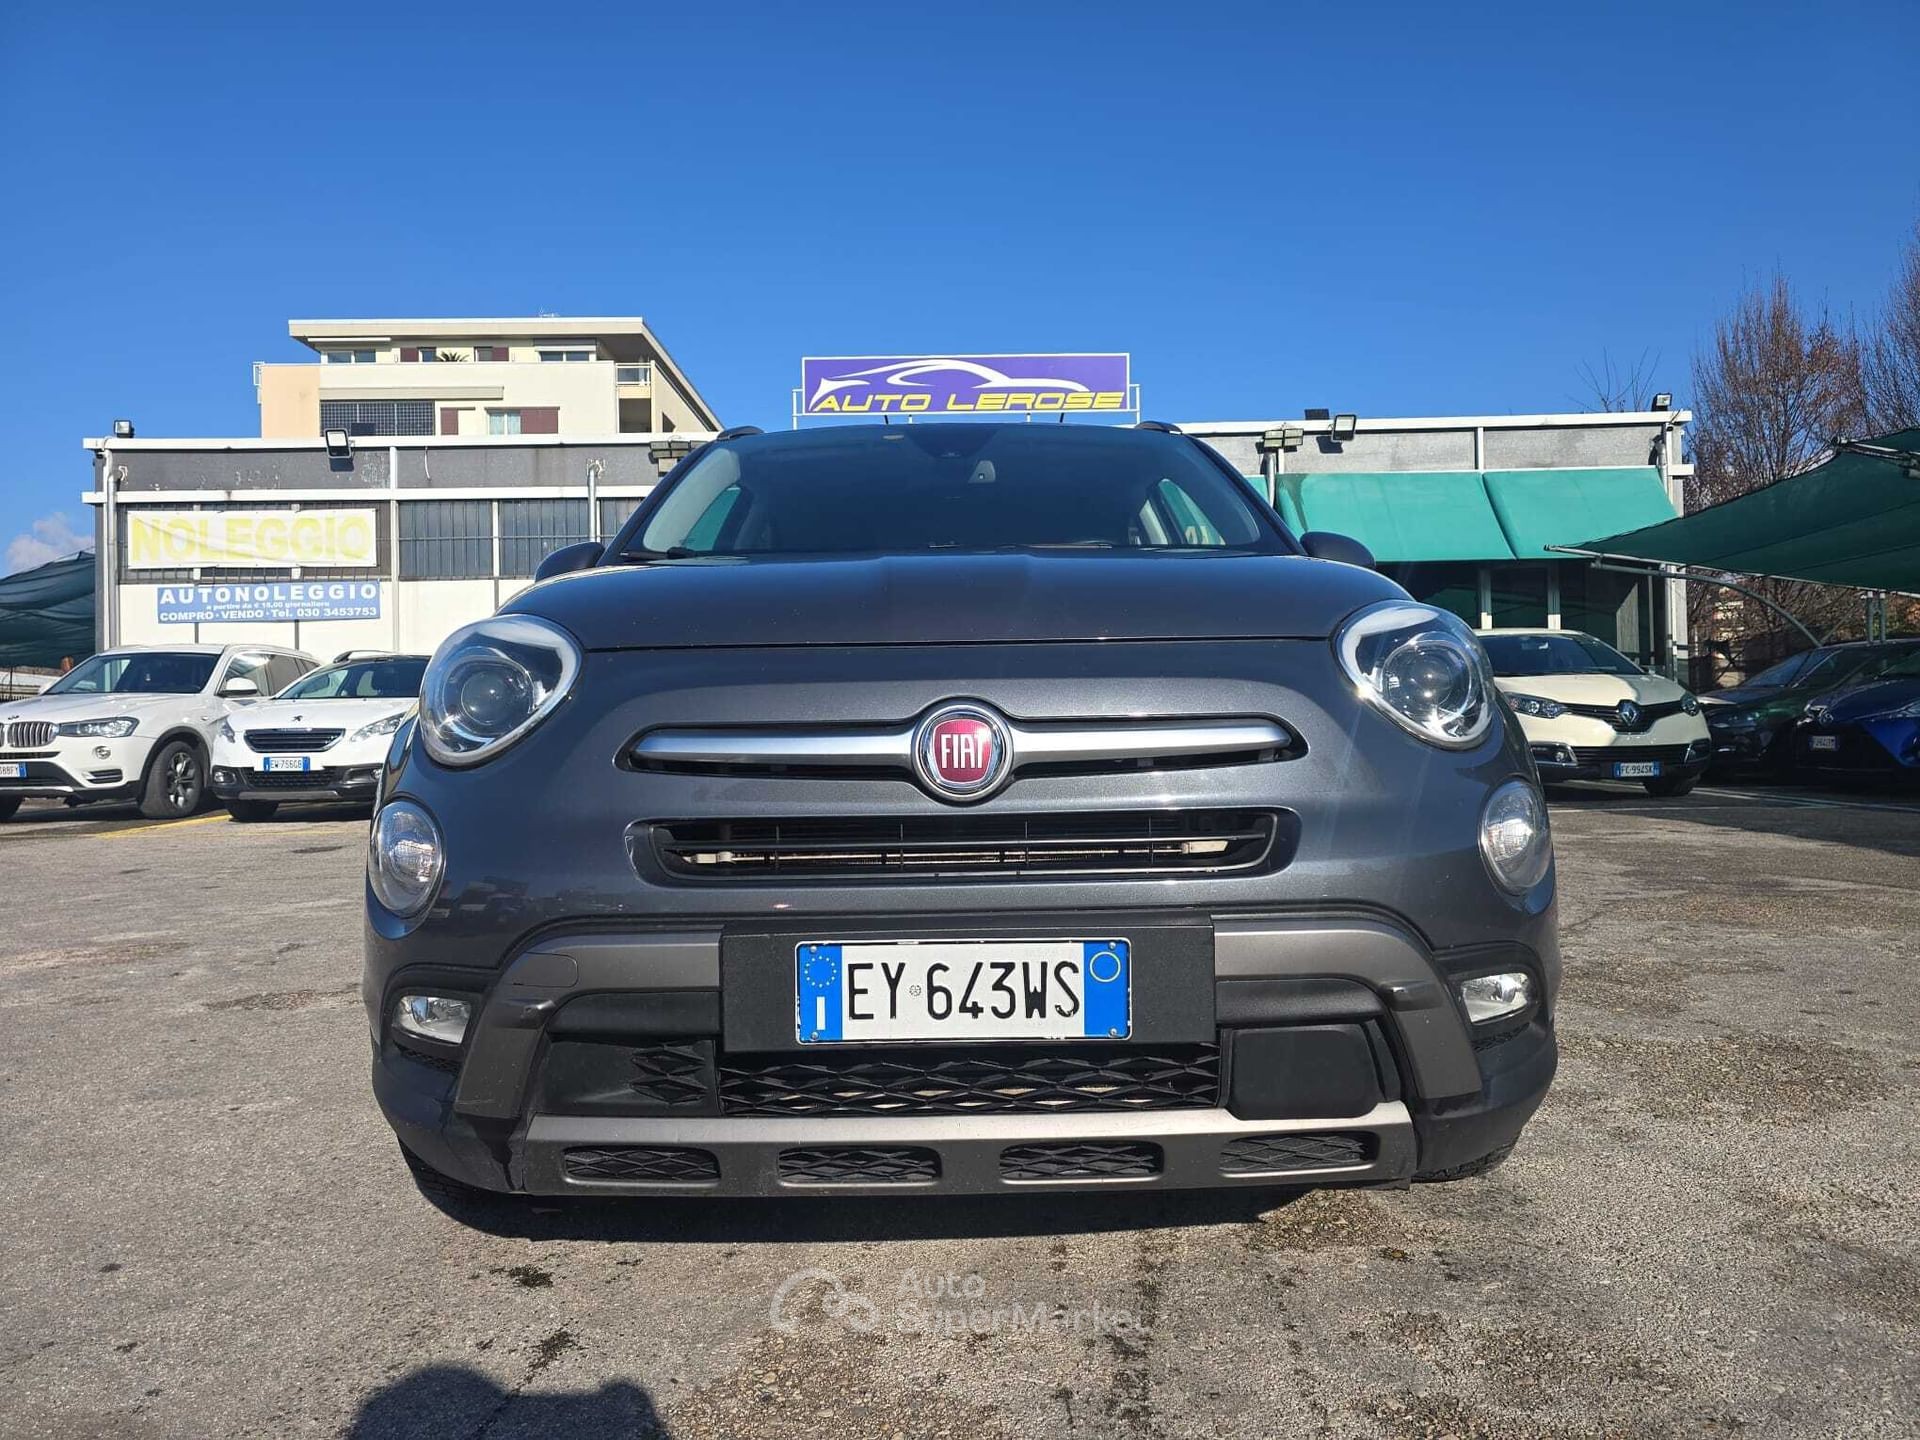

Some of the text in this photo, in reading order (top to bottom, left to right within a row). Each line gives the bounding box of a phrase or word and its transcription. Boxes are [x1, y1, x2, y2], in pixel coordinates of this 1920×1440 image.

[812, 391, 1125, 412] AUTO LEROSE
[131, 516, 371, 562] NOLEGGIO
[160, 584, 376, 604] AUTONOLEGGIO
[160, 607, 377, 622] COMPRO VENDO Tel. 030 3453753
[941, 733, 988, 769] FIAT
[848, 962, 906, 1020] EY
[926, 961, 1080, 1020] 643WS
